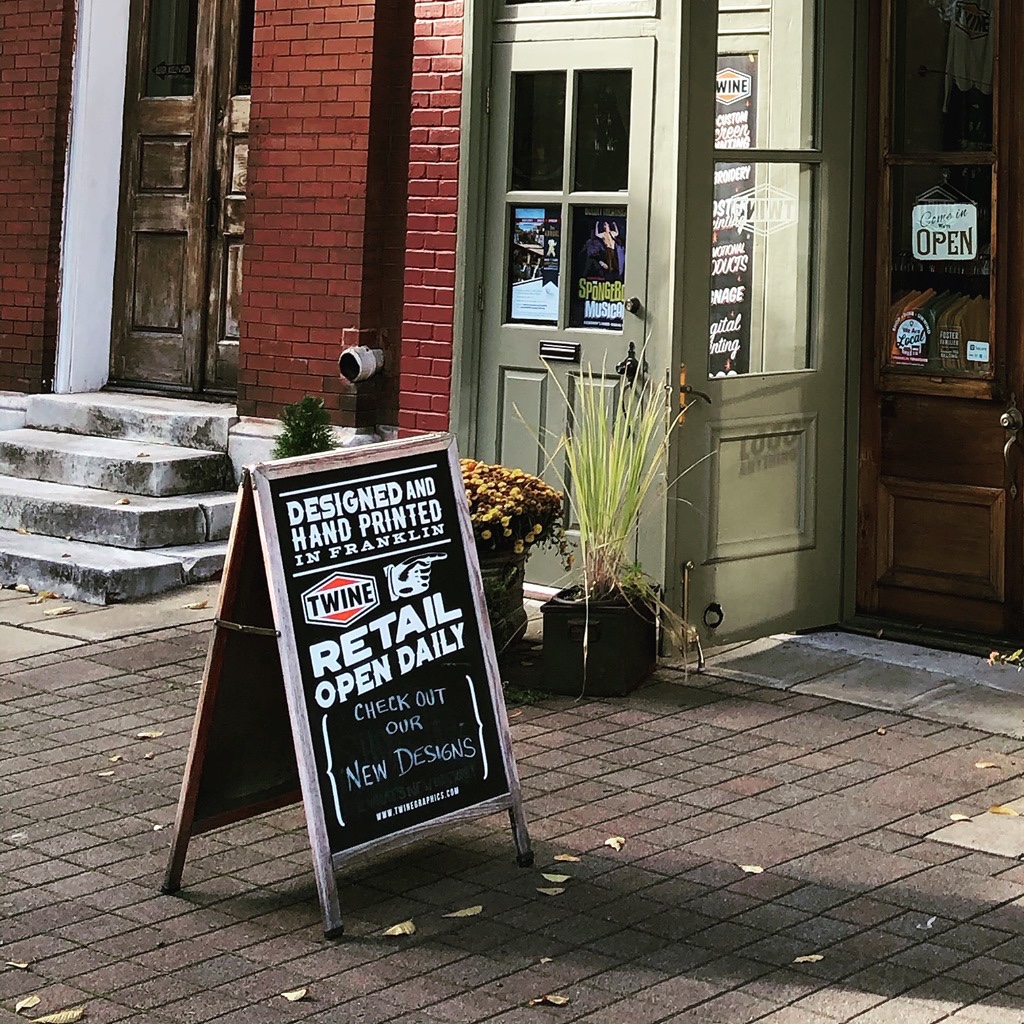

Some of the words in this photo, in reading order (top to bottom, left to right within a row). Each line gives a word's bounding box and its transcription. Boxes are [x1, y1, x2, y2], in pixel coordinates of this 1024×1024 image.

[955, 208, 968, 219] in
[916, 226, 973, 256] OPEN
[584, 300, 625, 320] MUSICA
[898, 329, 925, 347] Local
[286, 481, 403, 526] DESIGNED
[406, 476, 436, 500] AND
[291, 517, 352, 552] HAND
[358, 499, 443, 538] PRINTED
[294, 551, 321, 567] IN
[328, 524, 445, 559] FRANKLIN
[307, 582, 374, 617] TWINE
[309, 592, 463, 679] RETAIL
[314, 654, 393, 709] OPEN
[396, 622, 465, 676] DAILY
[354, 693, 411, 721] CHECK
[415, 687, 447, 707] OUT
[385, 715, 424, 735] OUR
[345, 759, 388, 792] NEW
[393, 737, 477, 777] DESIGNS
[375, 786, 460, 822] WWW.TWINEGRAPHICS.COM
